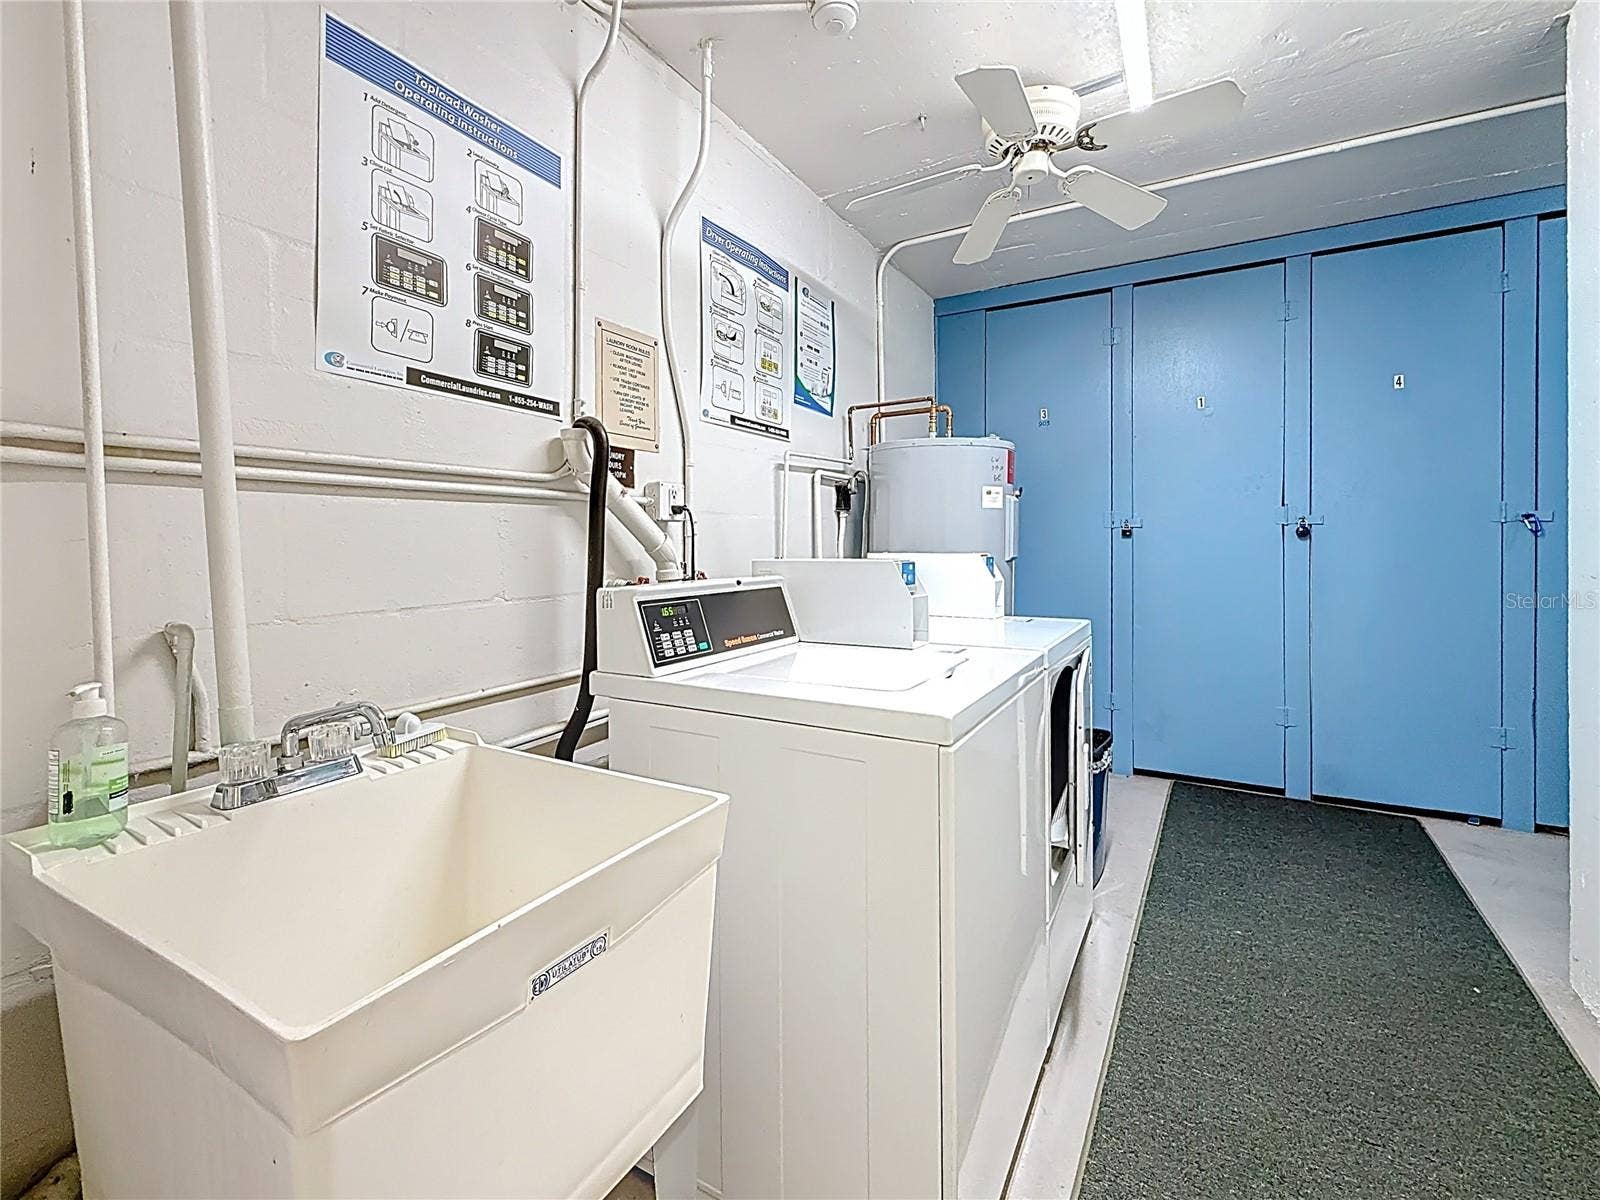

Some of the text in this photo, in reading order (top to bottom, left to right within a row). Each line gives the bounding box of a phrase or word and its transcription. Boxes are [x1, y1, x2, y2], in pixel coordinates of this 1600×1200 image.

[363, 92, 368, 101] 1
[414, 72, 503, 134] Topload Washer
[394, 79, 521, 160] Operating Instructions
[466, 148, 473, 157] 2
[361, 156, 368, 166] 3
[465, 205, 472, 214] 4
[361, 221, 369, 231] 5
[706, 227, 726, 245] Dryer
[725, 239, 759, 266] Operating
[465, 263, 472, 271] 6
[361, 285, 369, 296] 7
[465, 318, 472, 328] 8
[420, 374, 501, 400] CommercialLaundries.com
[1395, 375, 1403, 388] 4
[1198, 396, 1204, 408] 1
[1041, 408, 1047, 419] 3
[724, 637, 741, 648] Speed
